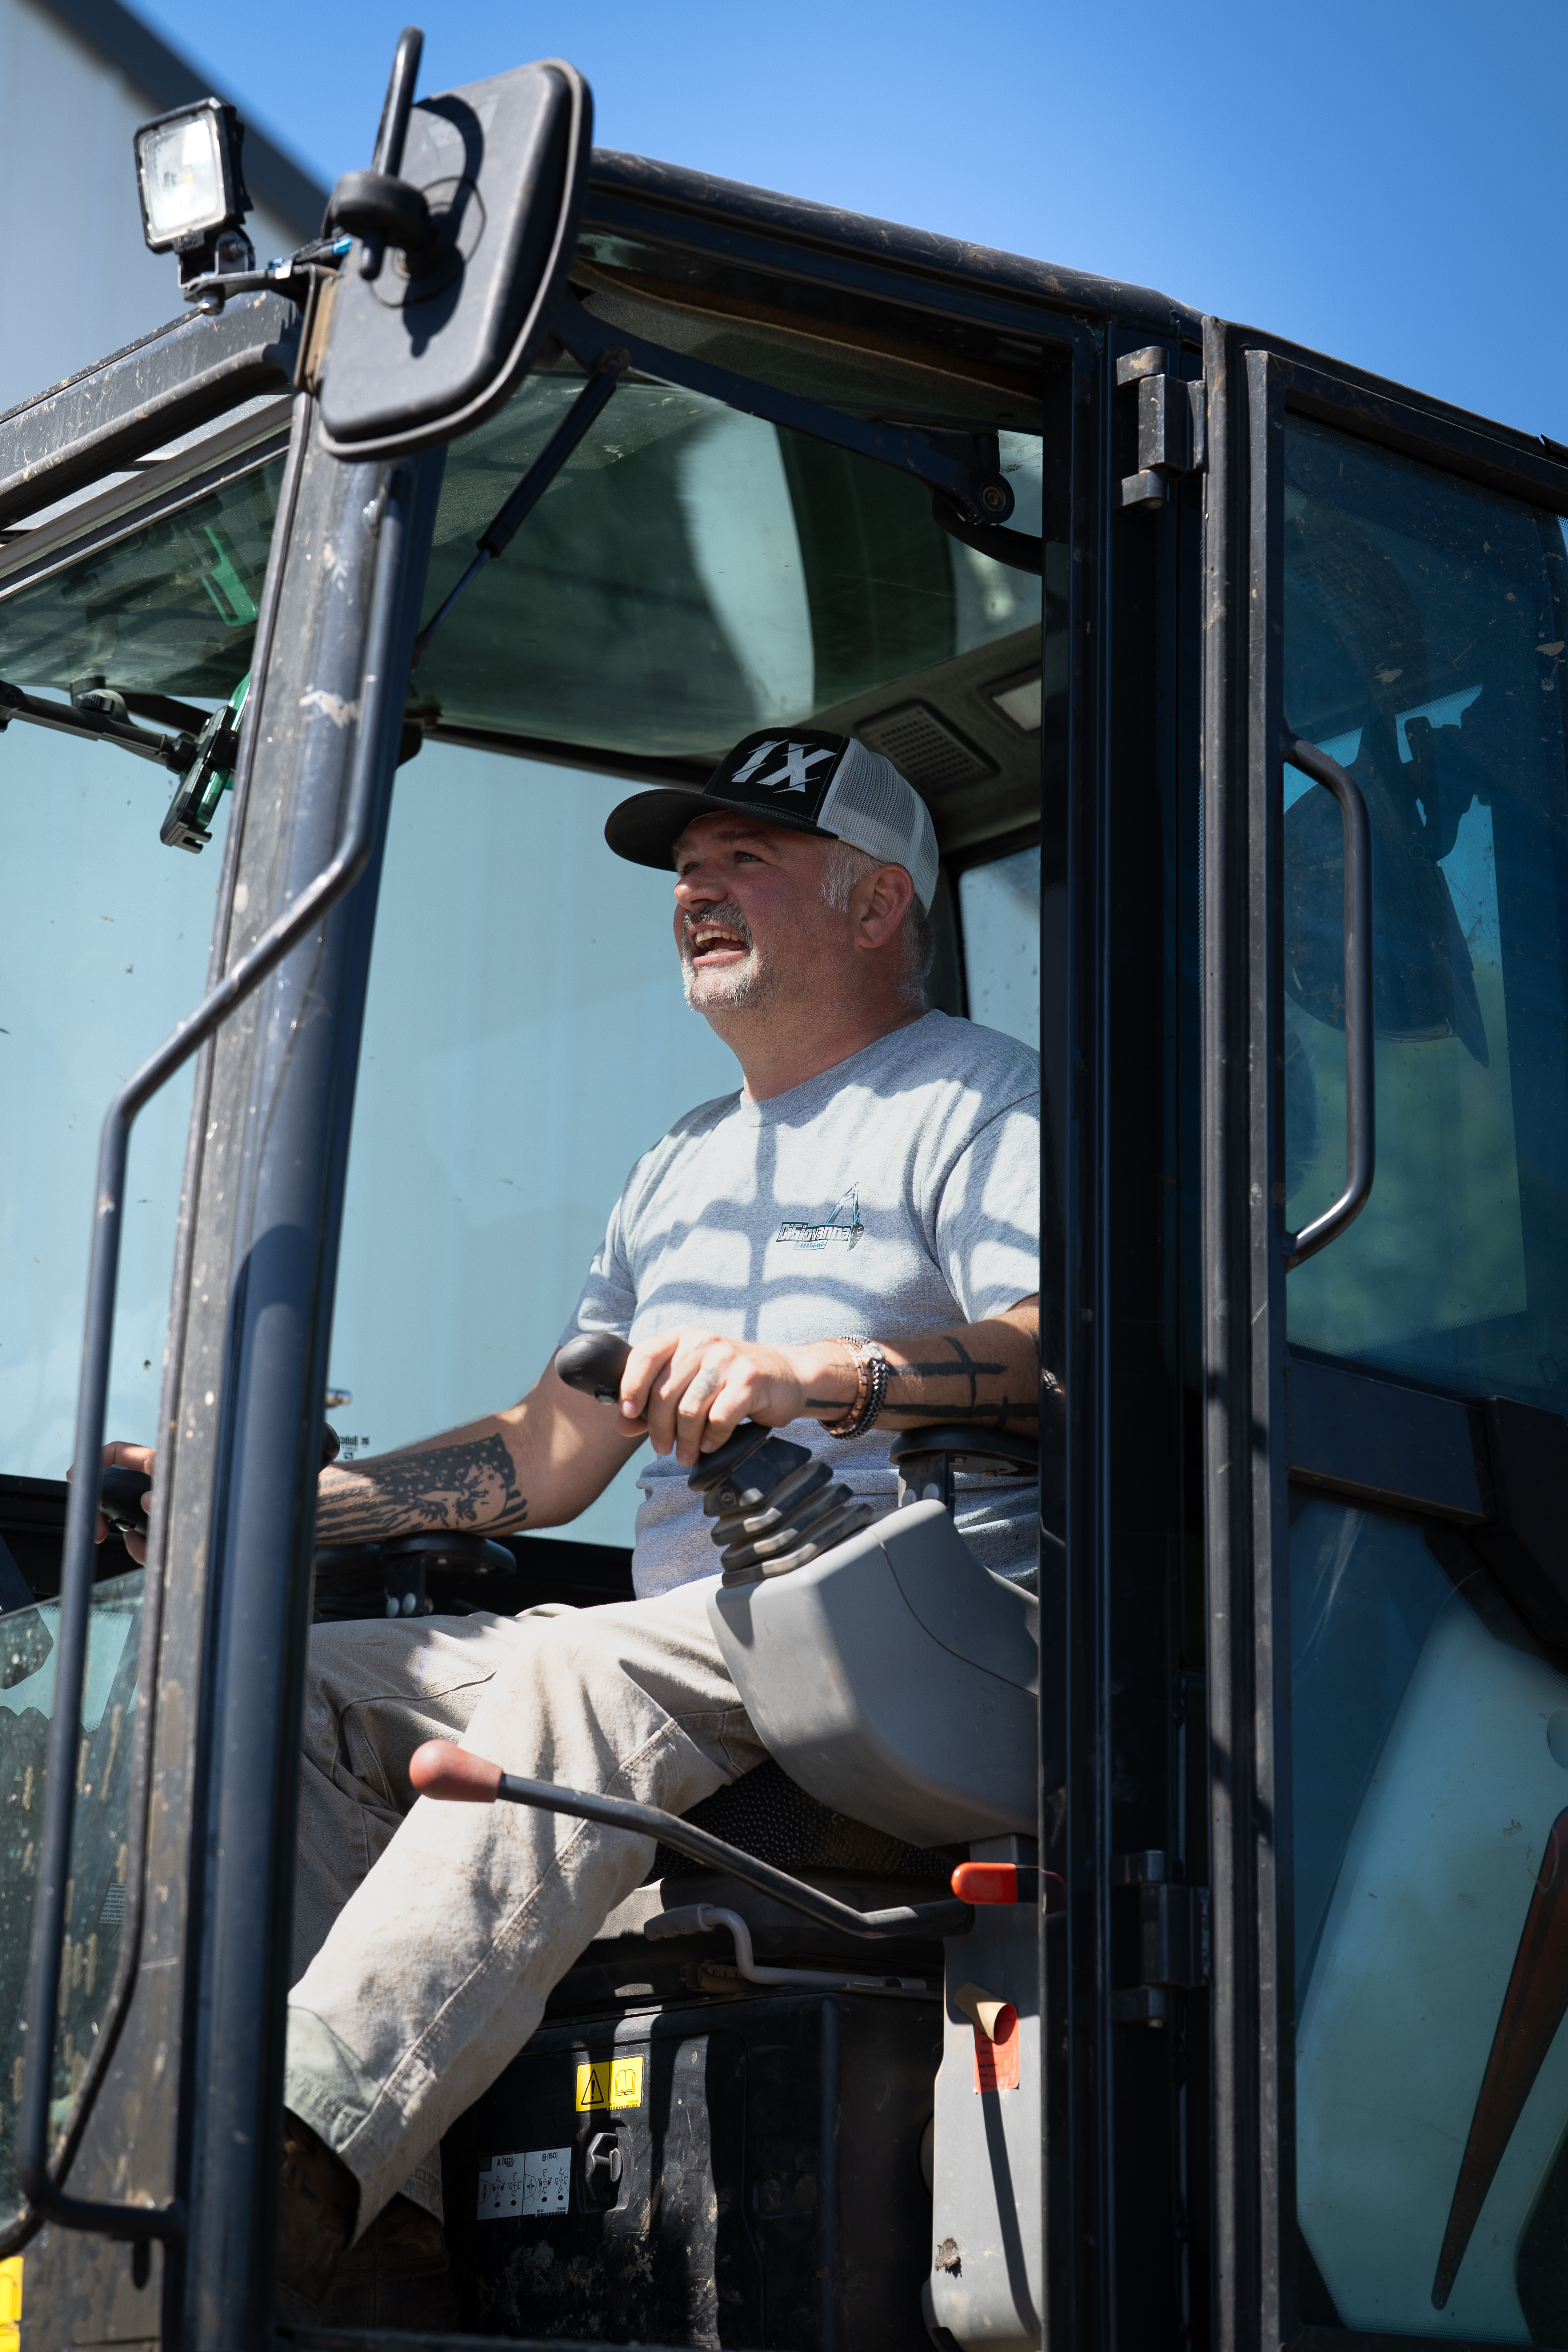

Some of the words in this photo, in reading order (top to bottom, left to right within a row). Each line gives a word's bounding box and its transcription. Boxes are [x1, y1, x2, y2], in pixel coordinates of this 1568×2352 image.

[778, 1223, 850, 1240] DiGiovanna
[547, 2152, 557, 2160] (ISO)
[502, 2157, 514, 2166] (STD)
